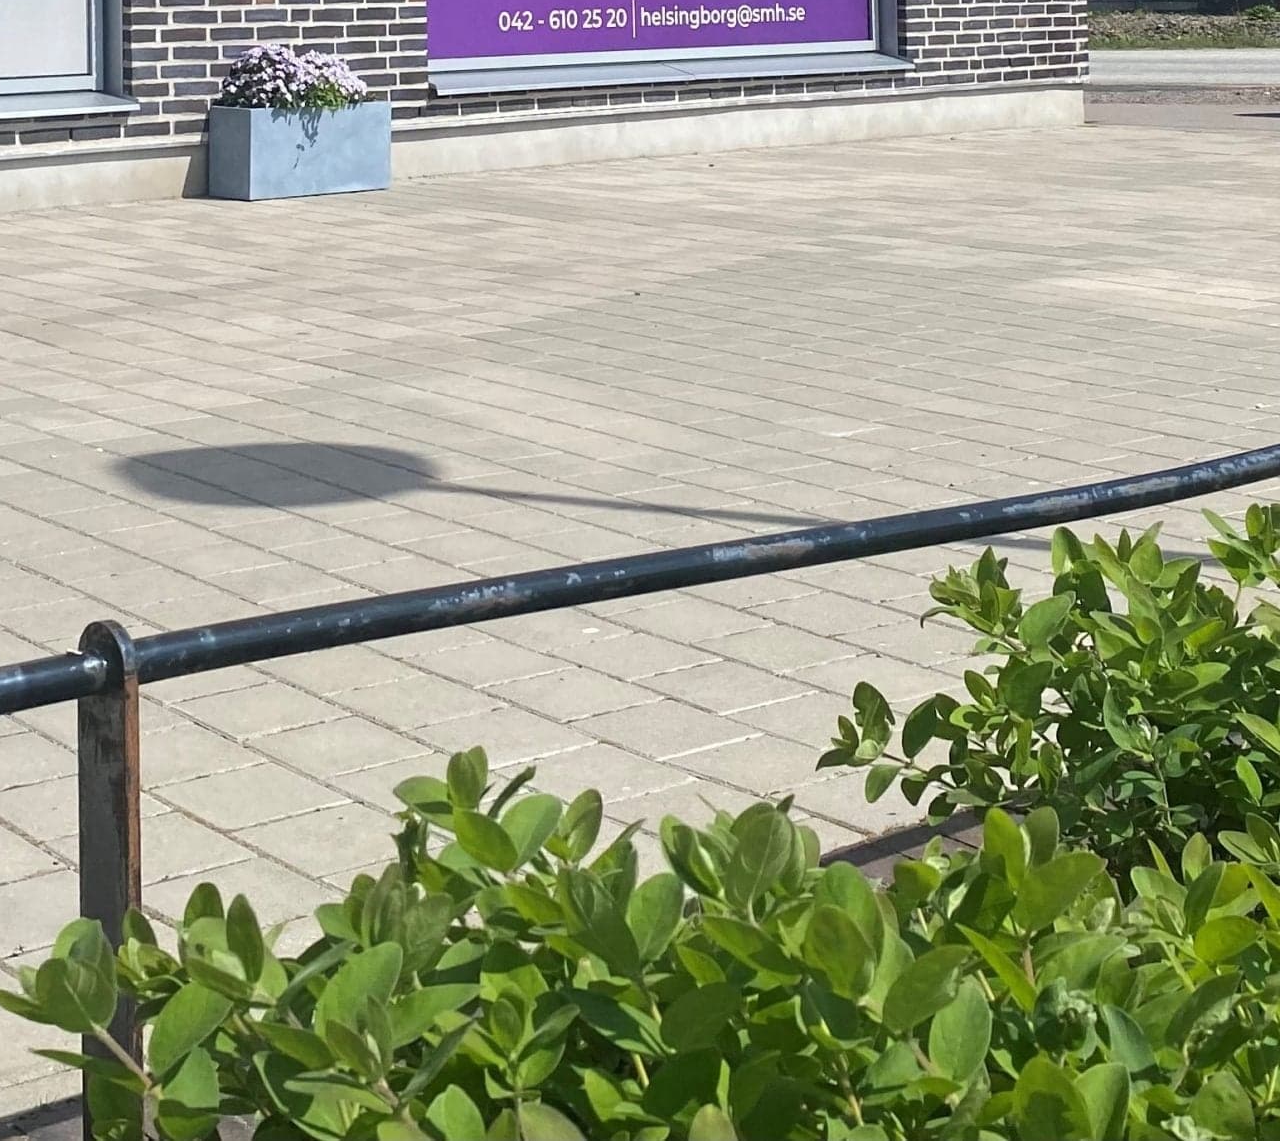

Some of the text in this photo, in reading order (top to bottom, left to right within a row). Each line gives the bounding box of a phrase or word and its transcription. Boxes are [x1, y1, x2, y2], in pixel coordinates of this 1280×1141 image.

[498, 10, 534, 32] 042
[549, 8, 578, 31] 610
[582, 8, 603, 30] 25
[606, 7, 627, 29] 20
[640, 3, 806, 32] helsingborg@smh.se
